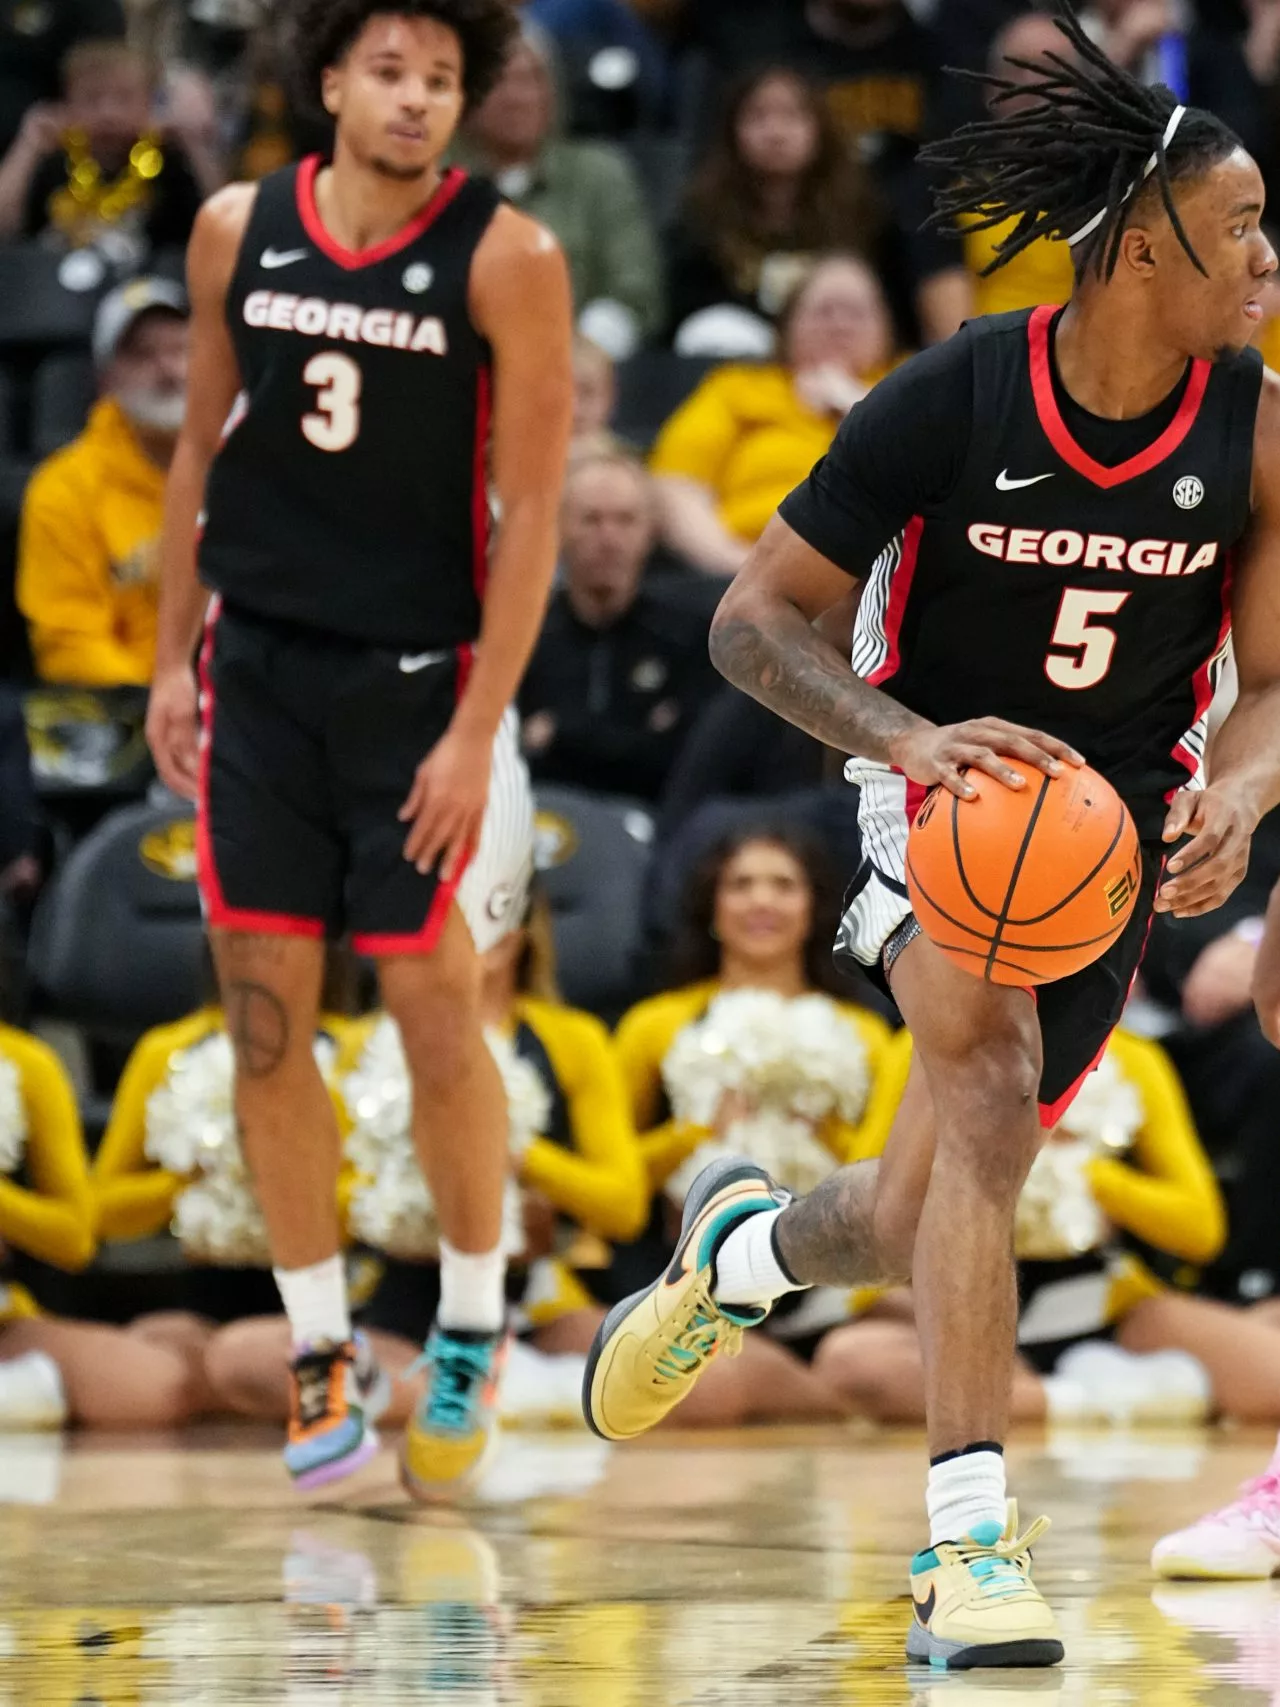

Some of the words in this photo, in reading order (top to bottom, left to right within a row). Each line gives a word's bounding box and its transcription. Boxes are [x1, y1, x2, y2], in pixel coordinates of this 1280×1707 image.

[242, 290, 447, 357] GEORGIA
[301, 351, 361, 453] 3
[1174, 478, 1202, 507] SEC
[966, 522, 1219, 577] GEORGIA
[1043, 585, 1134, 691] 5
